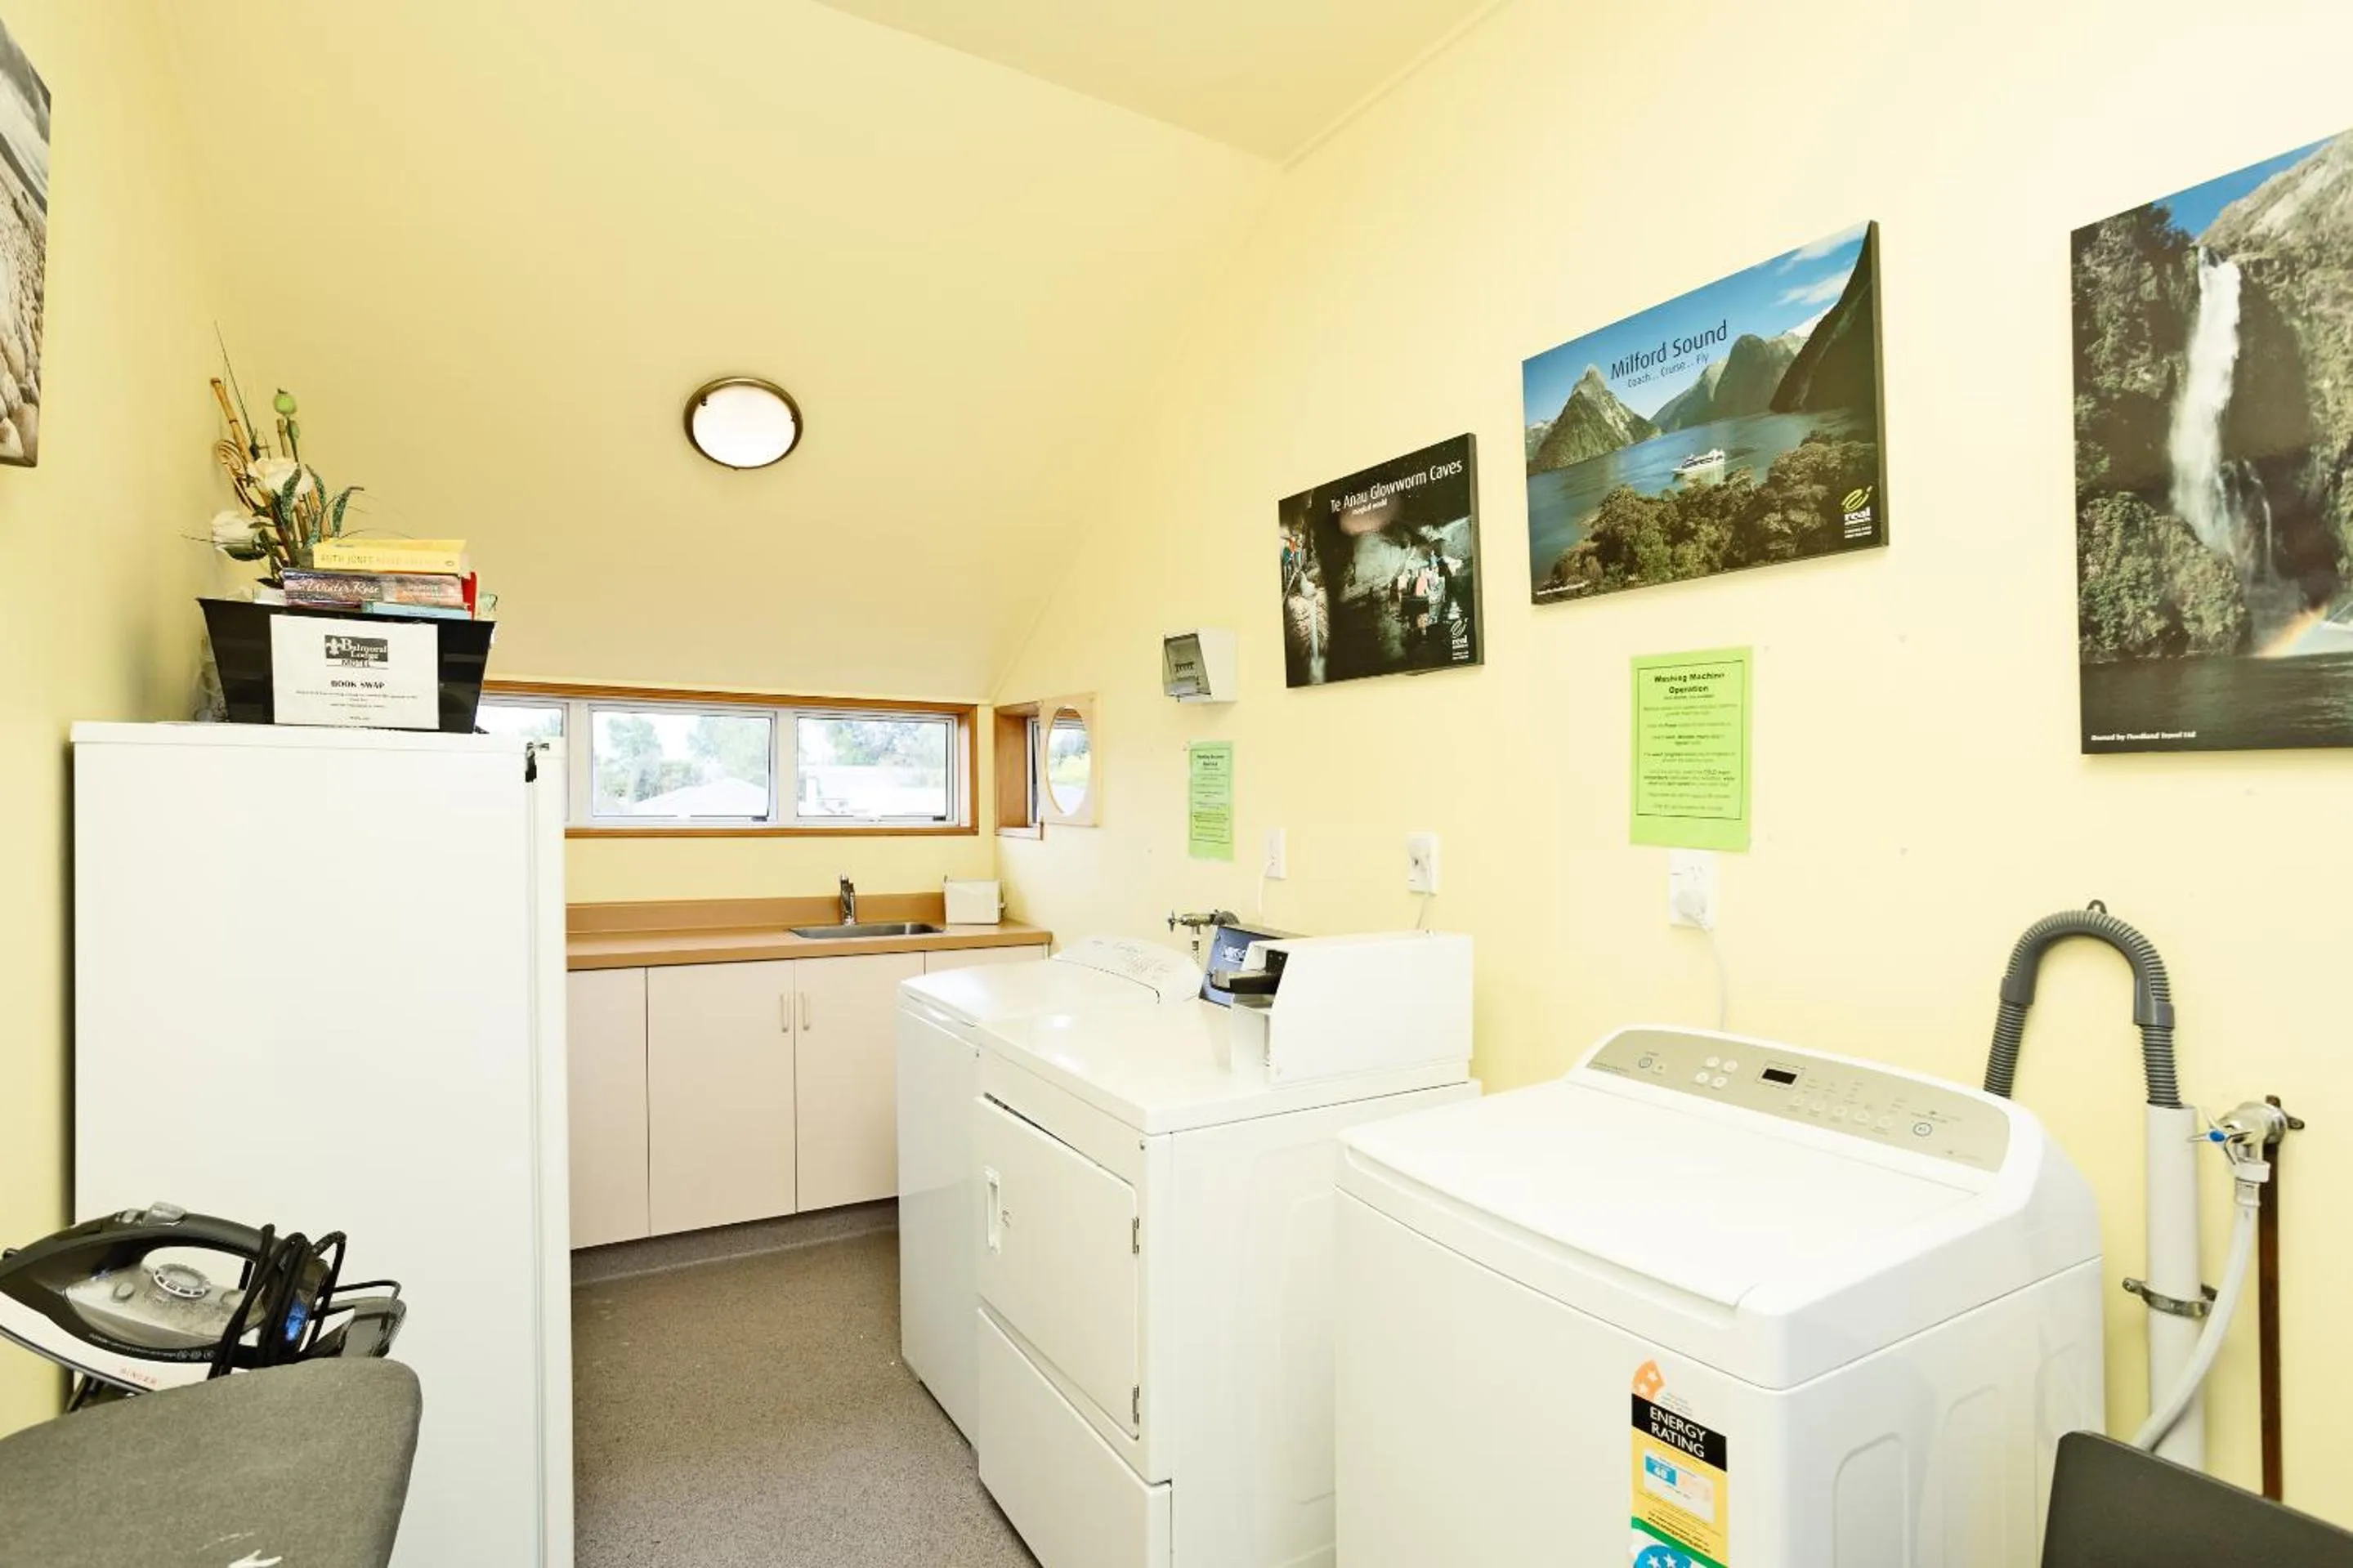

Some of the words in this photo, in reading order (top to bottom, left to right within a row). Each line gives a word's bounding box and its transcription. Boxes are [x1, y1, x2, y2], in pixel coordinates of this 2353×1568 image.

[1610, 341, 1667, 380] Milford
[1672, 319, 1727, 358] Sound
[1330, 499, 1342, 513] Te
[1344, 491, 1367, 509] Anau
[1370, 471, 1427, 500] Glowworm
[1429, 460, 1463, 480] Caves
[330, 680, 357, 688] BOOK
[360, 680, 385, 689] SWAP
[1654, 674, 1687, 683] Washing
[1689, 672, 1724, 681] Machine
[1668, 685, 1709, 695] Operation
[1649, 1405, 1707, 1443] ENERGY
[1650, 1422, 1705, 1459] RATING
